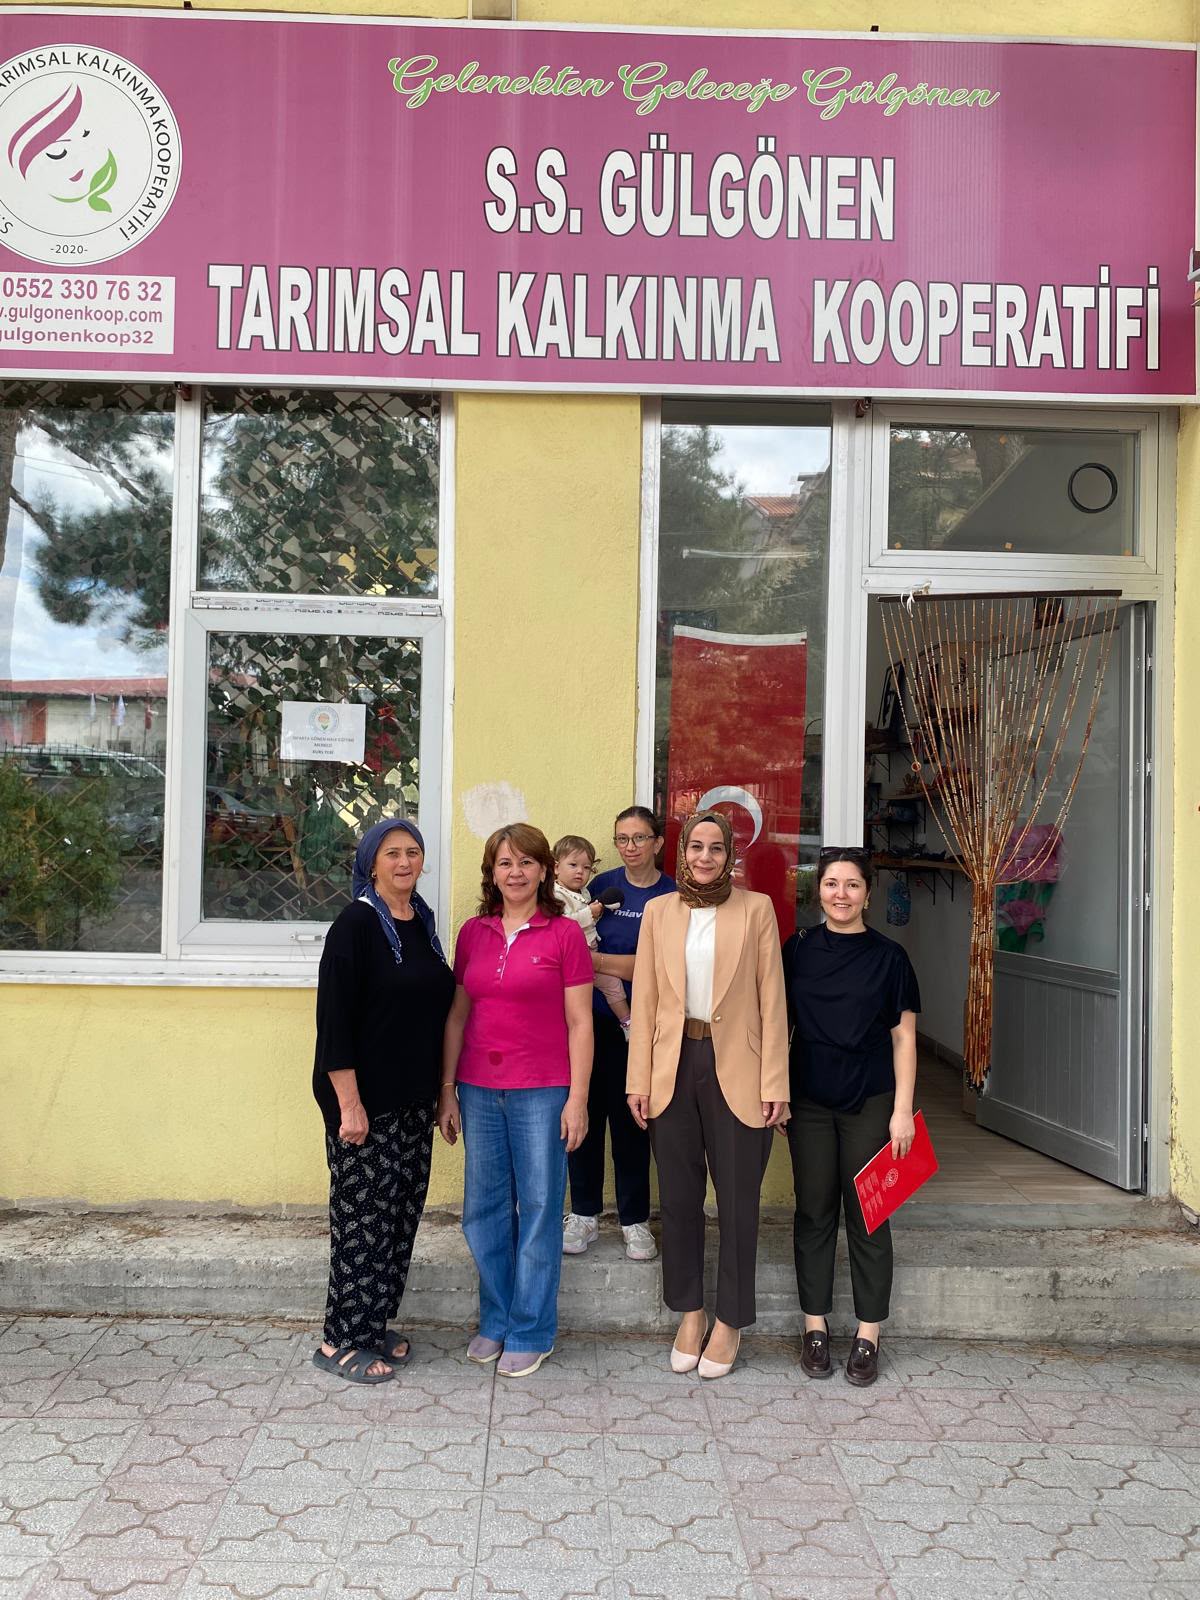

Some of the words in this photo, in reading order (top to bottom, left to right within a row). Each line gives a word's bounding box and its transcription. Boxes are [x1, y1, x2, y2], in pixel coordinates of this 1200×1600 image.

[388, 55, 614, 109] Gelenekten
[618, 62, 798, 116] Geleceğe
[802, 67, 1001, 120] Gülgönen
[77, 52, 160, 118] KALKINMA
[119, 118, 172, 241] KOOPERATİFİ
[484, 146, 583, 234] S.S.
[600, 132, 895, 242] GÜLGÖNEN
[2, 277, 53, 299] 0552
[60, 279, 98, 300] 330
[105, 280, 130, 301] 76
[137, 281, 162, 301] 32
[208, 264, 480, 357] TARIMSAL
[496, 271, 781, 363] KALKINMA
[813, 264, 1160, 371] KOOPERATİFİ
[0, 327, 154, 346] ulgonenkoop32
